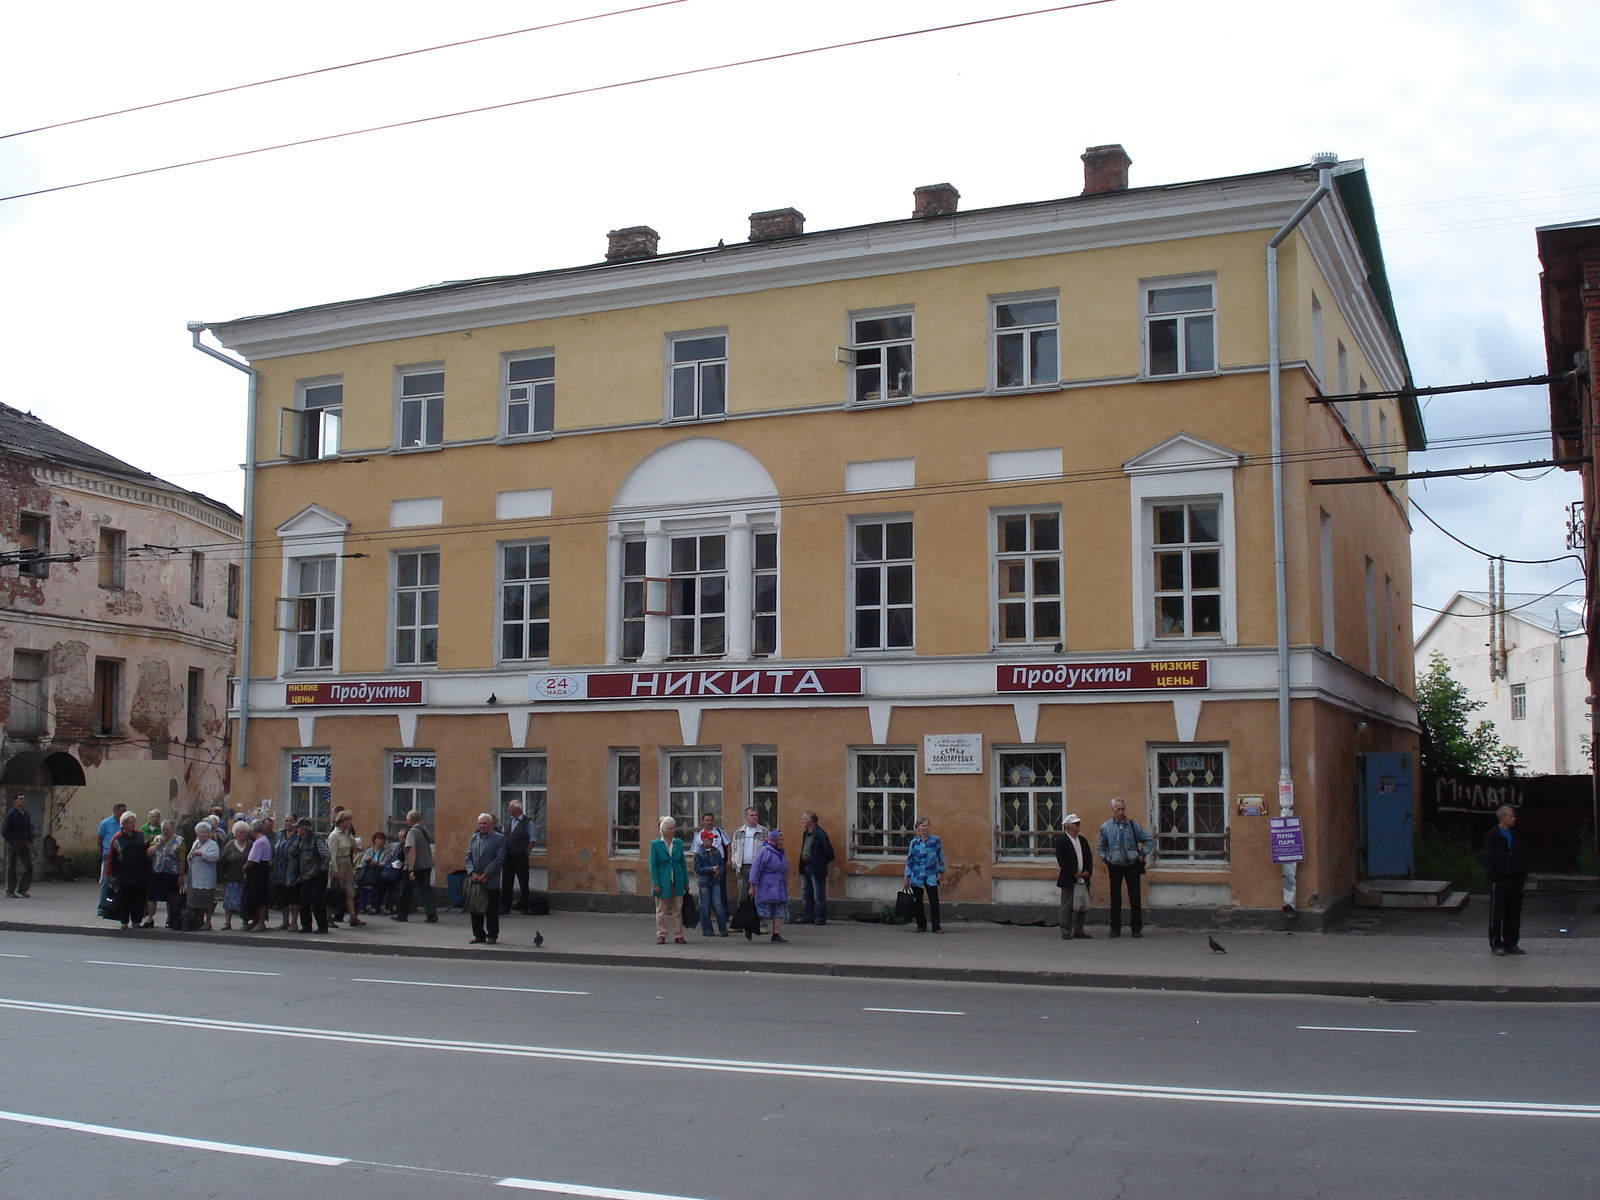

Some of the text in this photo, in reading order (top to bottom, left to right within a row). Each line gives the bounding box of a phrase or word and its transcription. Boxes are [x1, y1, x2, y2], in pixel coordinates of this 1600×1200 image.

[1151, 661, 1200, 672] НИЗКИЕ
[1013, 665, 1132, 688] Продукты
[1157, 676, 1195, 686] ЦЕНЫ
[288, 684, 319, 692] НИЗКИЕ
[546, 678, 568, 689] 24
[630, 670, 825, 695] НИКИТА
[330, 683, 410, 702] Продукты
[291, 695, 315, 704] ЦЕНЫ
[299, 755, 331, 766] ПЕПСИ
[403, 757, 436, 768] PEPSI
